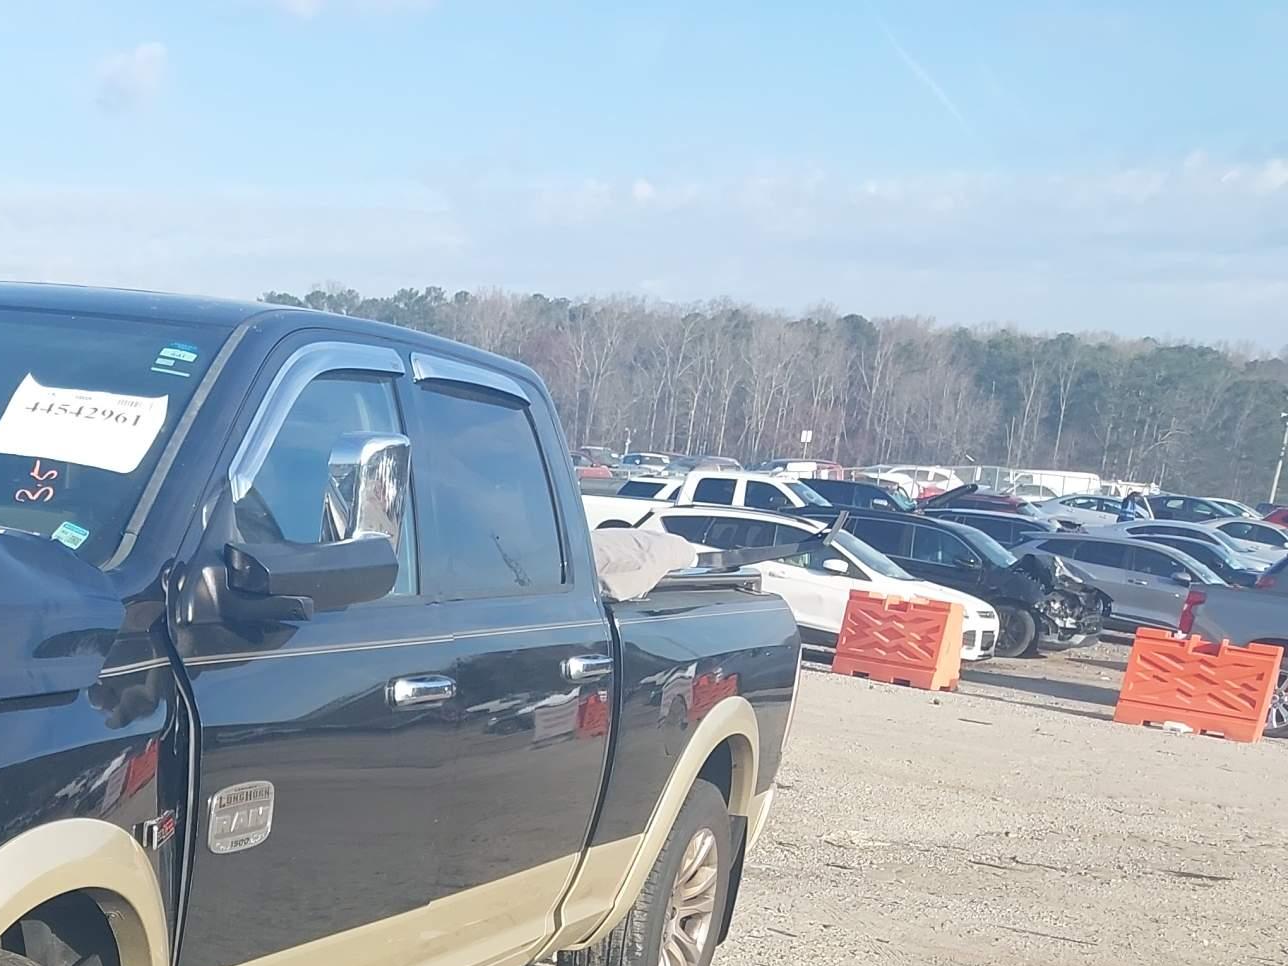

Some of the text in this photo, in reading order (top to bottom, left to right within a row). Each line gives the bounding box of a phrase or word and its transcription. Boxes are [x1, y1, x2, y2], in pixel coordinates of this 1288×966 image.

[25, 401, 141, 427] 44542961
[216, 806, 269, 833] RAM
[230, 837, 250, 849] 1500
